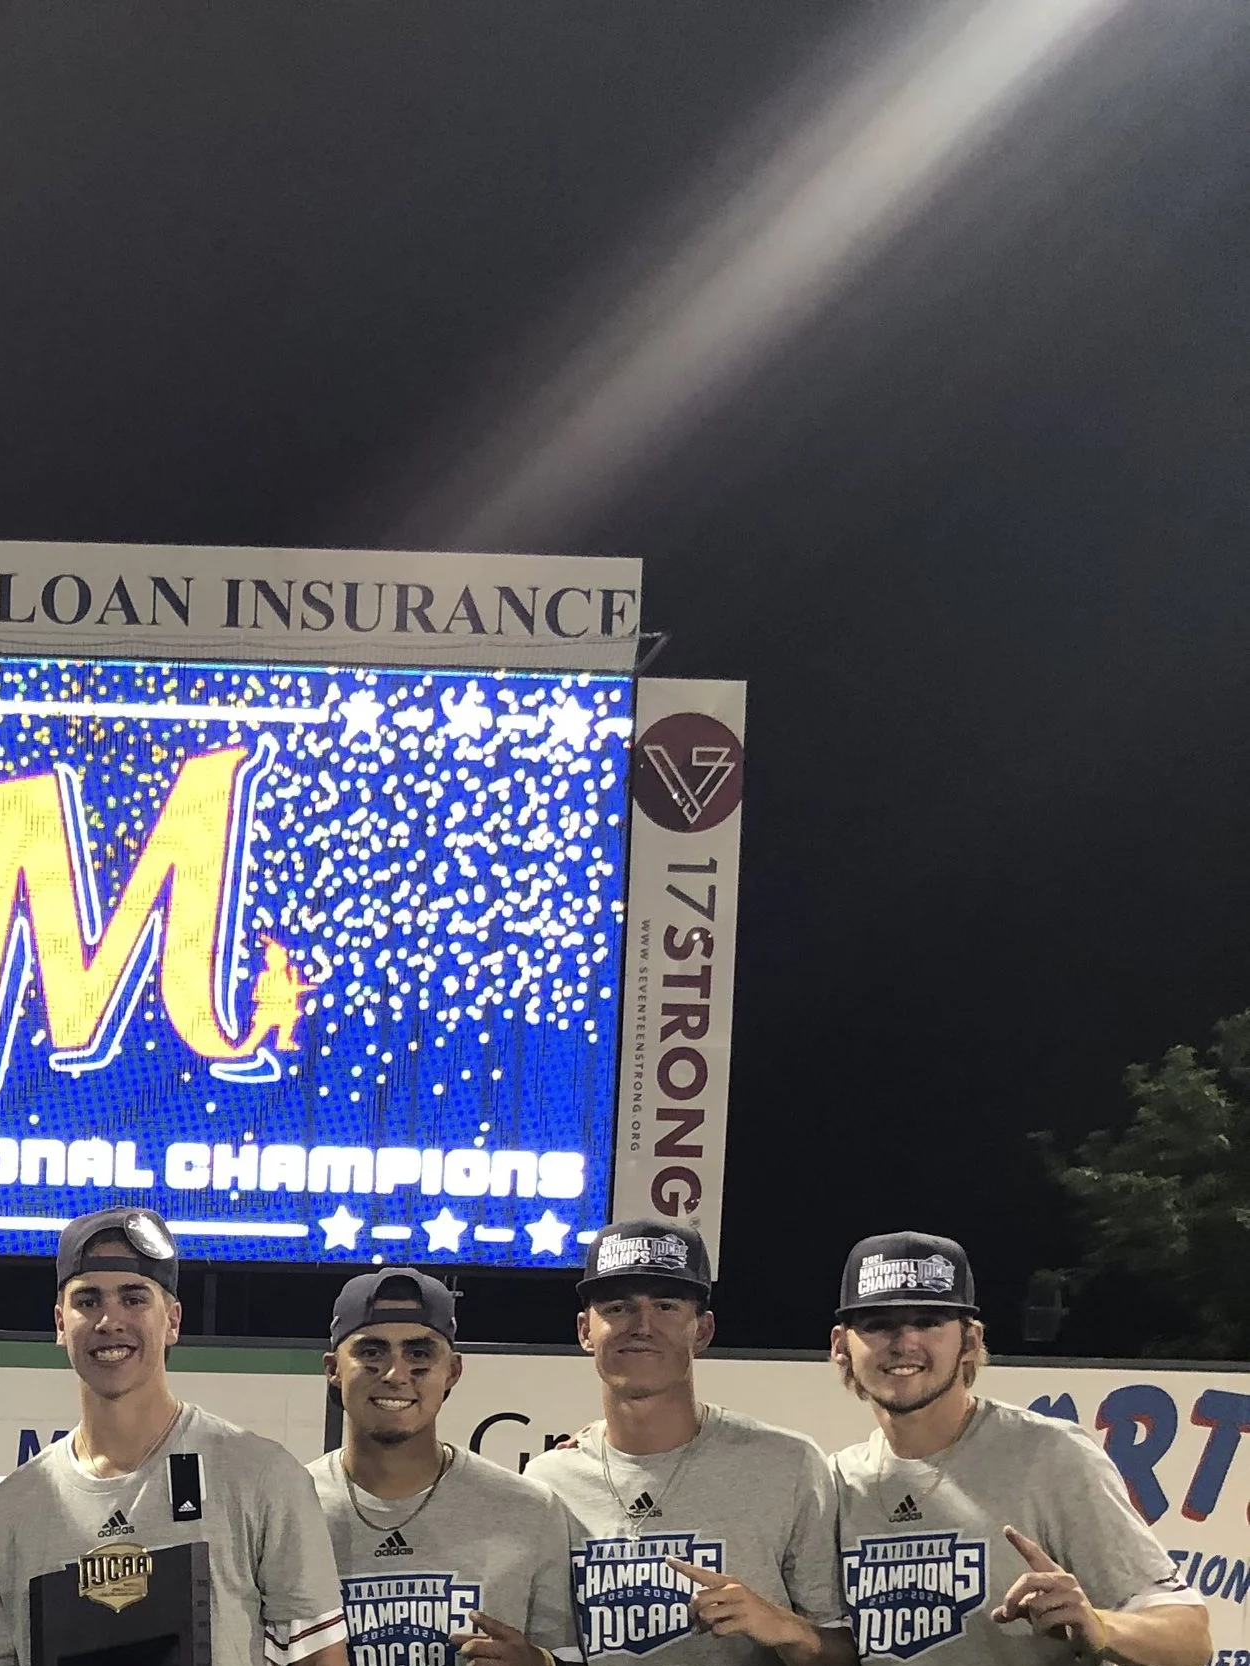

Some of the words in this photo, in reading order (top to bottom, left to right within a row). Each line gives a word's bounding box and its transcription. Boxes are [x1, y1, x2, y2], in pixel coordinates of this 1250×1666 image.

[223, 576, 638, 640] INSURANCE
[630, 919, 652, 1152] WWW.SEVENTEENSTRONG.ORG
[650, 857, 718, 1218] 17STRONG
[164, 1142, 585, 1200] CHAMPIONS
[599, 1239, 651, 1258] NATIONAL
[597, 1250, 651, 1272] CHAMPS
[859, 1261, 918, 1281] NATIONAL
[857, 1273, 918, 1295] CHAMPS
[888, 1511, 923, 1523] adidas
[97, 1524, 136, 1538] adidas
[374, 1546, 414, 1558] adidas
[595, 1541, 681, 1559] NATIONAL
[871, 1541, 944, 1561] NATIONAL
[79, 1554, 152, 1591] NJCAA
[842, 1548, 980, 1608] CHAMPIONS
[353, 1581, 439, 1599] NATIONAL
[598, 1588, 679, 1605] 2020-2021
[868, 1590, 942, 1606] 2020-2021
[345, 1590, 475, 1637] HAMPIONS
[362, 1626, 437, 1643] 2020-2021
[589, 1603, 688, 1653] NJCAA
[858, 1605, 951, 1656] NJCAA
